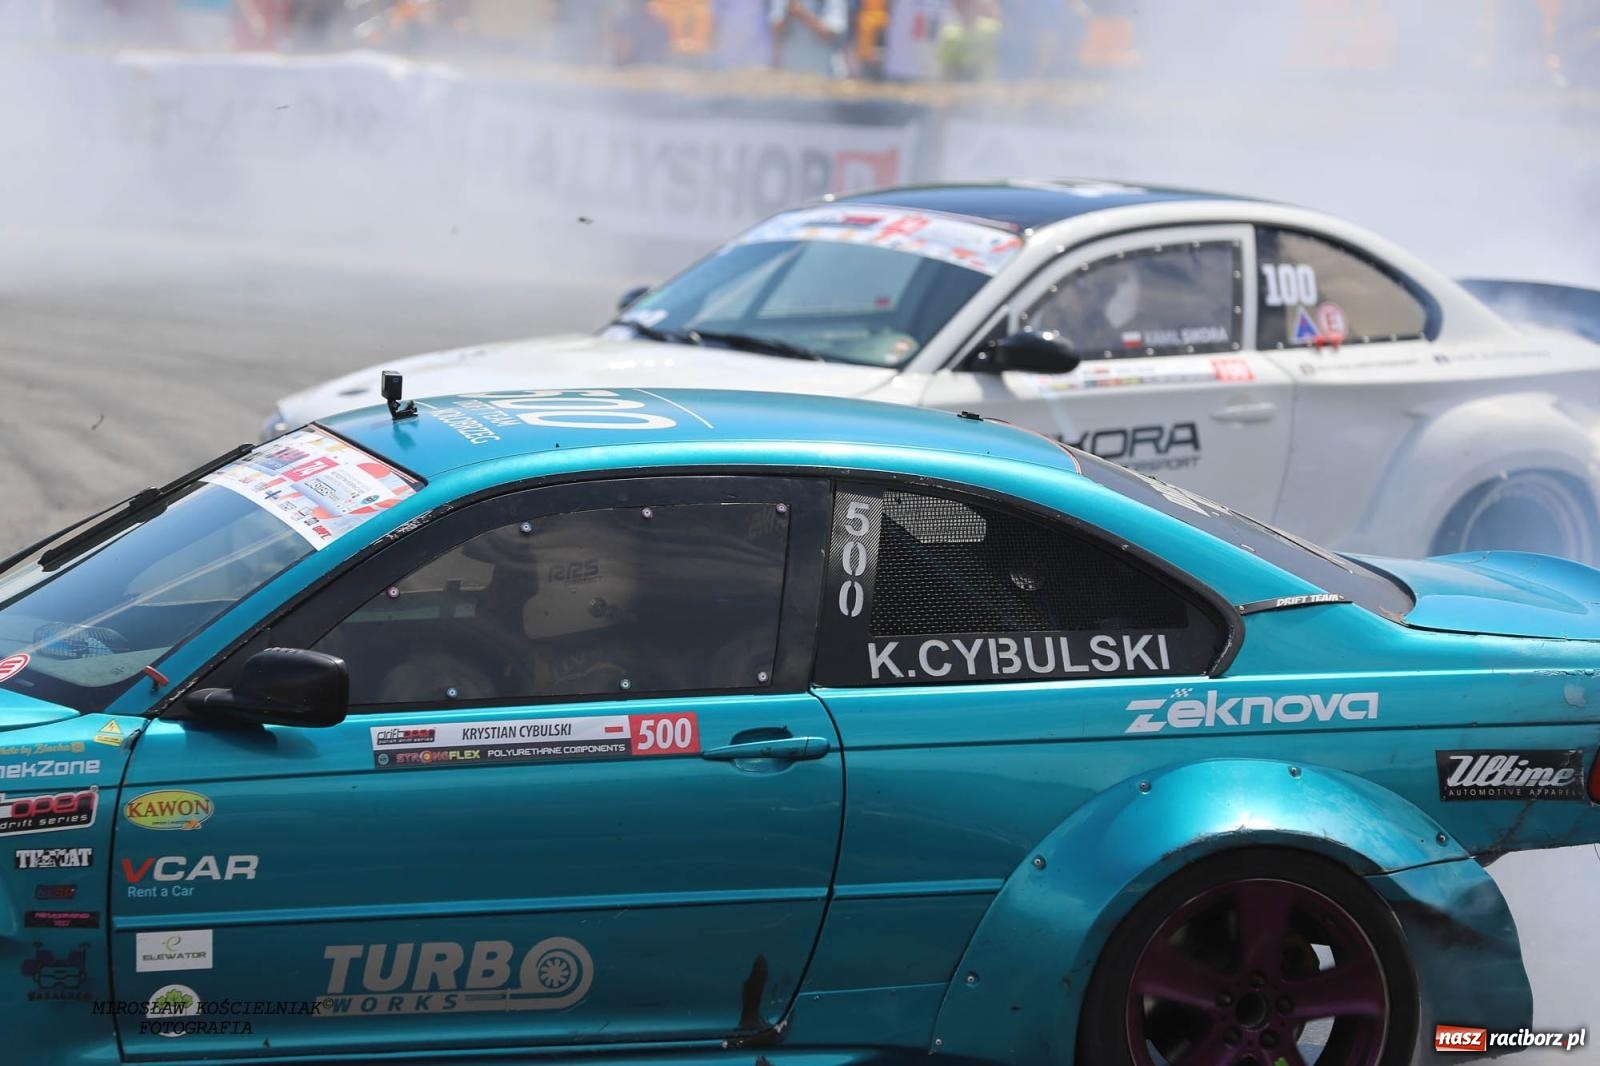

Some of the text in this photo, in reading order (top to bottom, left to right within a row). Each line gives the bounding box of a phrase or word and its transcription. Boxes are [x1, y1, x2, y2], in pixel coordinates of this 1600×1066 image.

[1261, 263, 1318, 307] 100
[838, 501, 871, 618] 500
[1276, 593, 1339, 607] DRIFT TEAM
[867, 633, 1171, 680] K.CYBULSKI
[462, 723, 572, 741] KRYSTIAN CYBULSKI
[637, 717, 692, 750] 500
[487, 743, 626, 758] POLYURETHANE COMPONENTS
[1449, 788, 1522, 796] AUTOMOTIVE
[127, 798, 210, 818] KAWON
[39, 813, 88, 826] series
[120, 854, 260, 884] VCAR
[127, 885, 195, 898] Rent a Car
[142, 951, 207, 962] ELEWATOR
[323, 936, 594, 1006] TURBO
[332, 994, 460, 1014] WORKS
